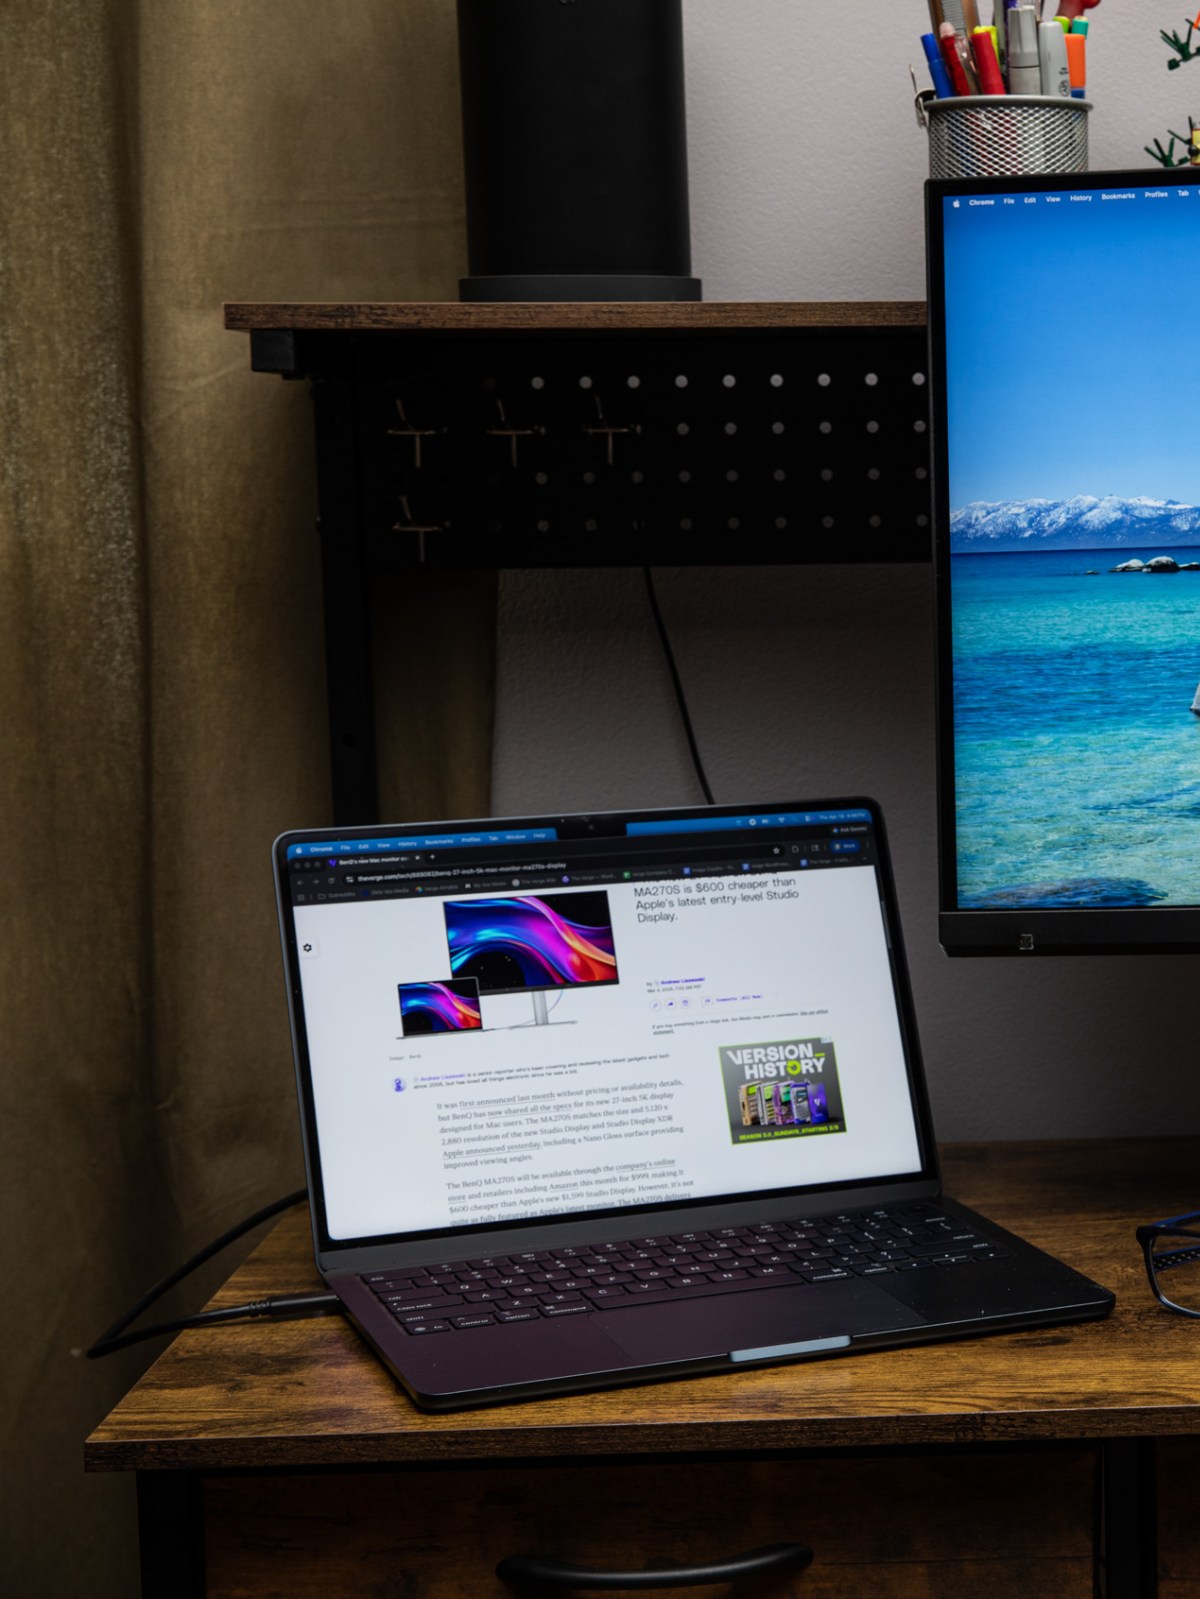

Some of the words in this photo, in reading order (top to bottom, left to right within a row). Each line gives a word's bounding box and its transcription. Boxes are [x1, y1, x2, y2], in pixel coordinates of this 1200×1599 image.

[1070, 194, 1092, 202] History
[1101, 192, 1135, 200] Bookmarks
[1144, 190, 1168, 200] Profiles
[633, 884, 681, 897] MA270S
[682, 884, 693, 894] is
[694, 880, 725, 893] $600
[726, 878, 770, 891] cheaper
[771, 876, 796, 887] than
[676, 896, 707, 907] latest
[708, 891, 764, 906] entry-level
[765, 888, 799, 900] Studio
[636, 910, 678, 925] Display.
